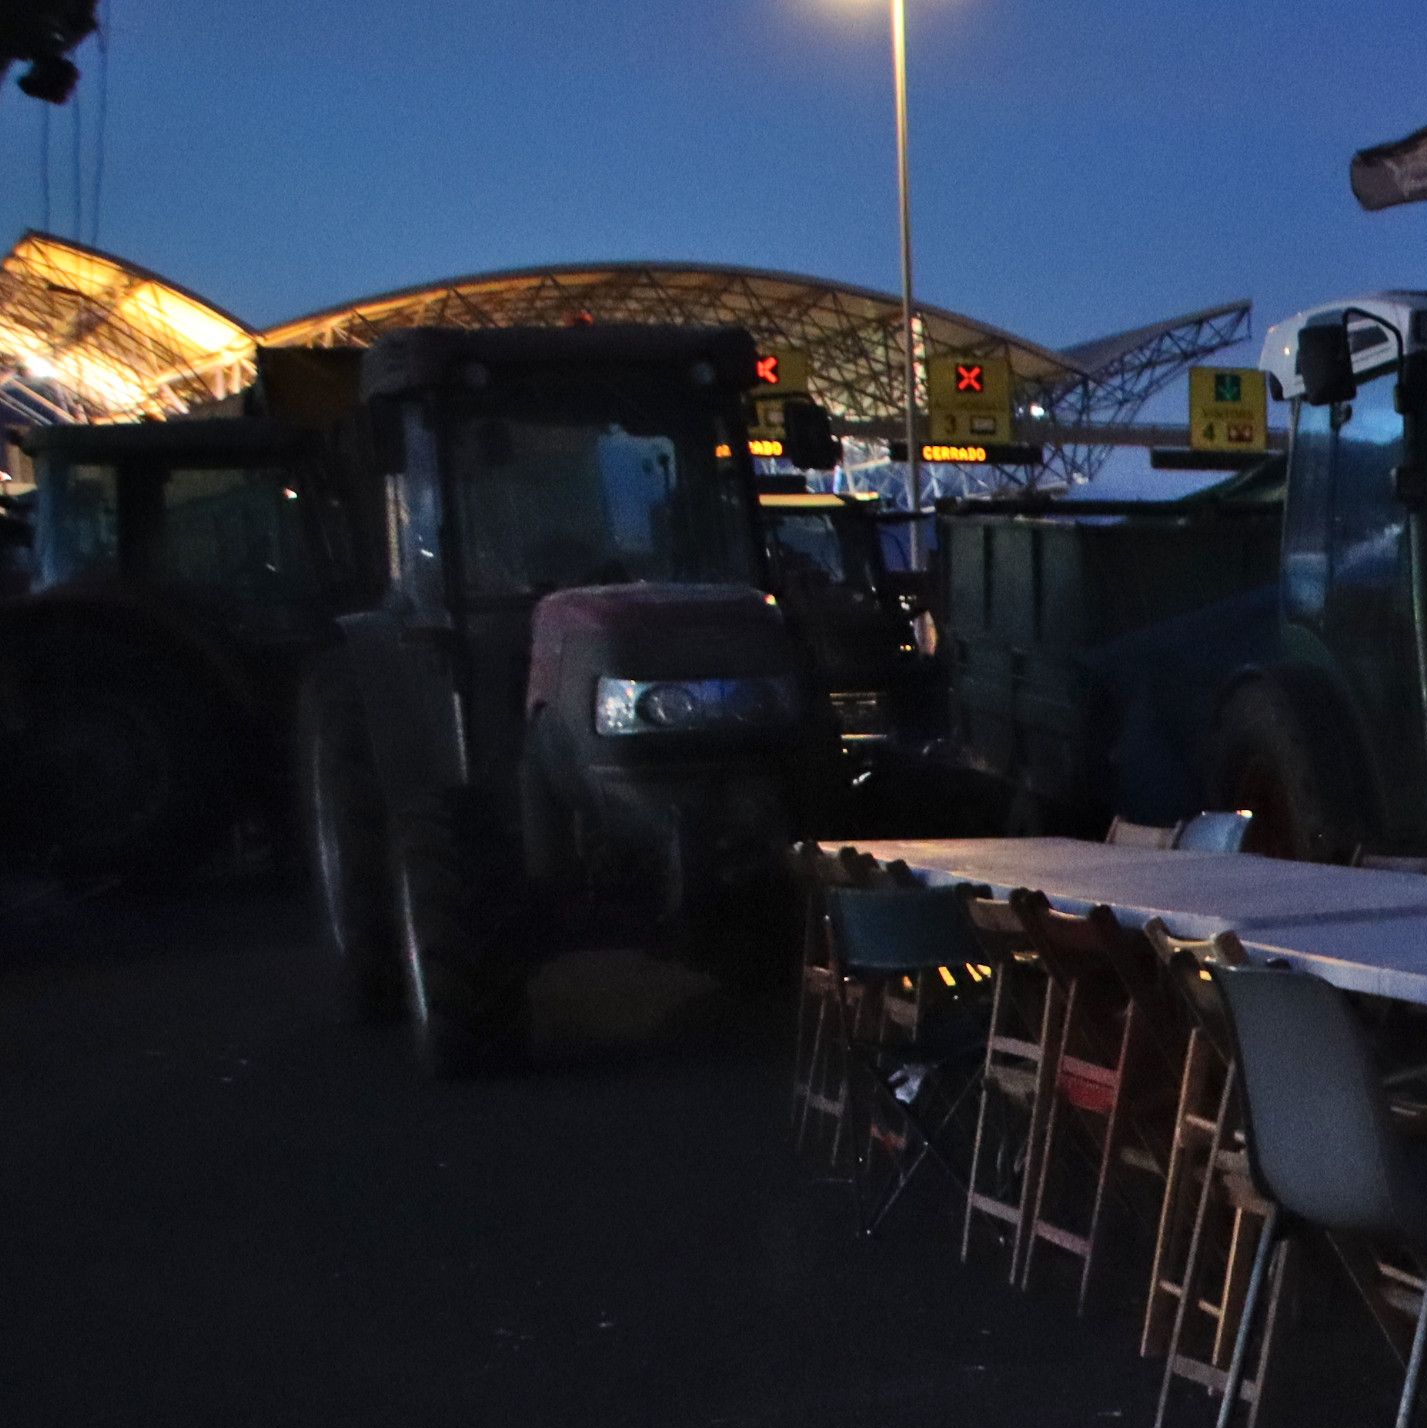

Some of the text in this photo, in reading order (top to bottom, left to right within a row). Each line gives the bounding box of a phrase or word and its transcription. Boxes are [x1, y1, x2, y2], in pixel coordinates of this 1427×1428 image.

[944, 414, 957, 435] 3
[1203, 422, 1216, 442] 4
[922, 445, 987, 462] CERRADO
